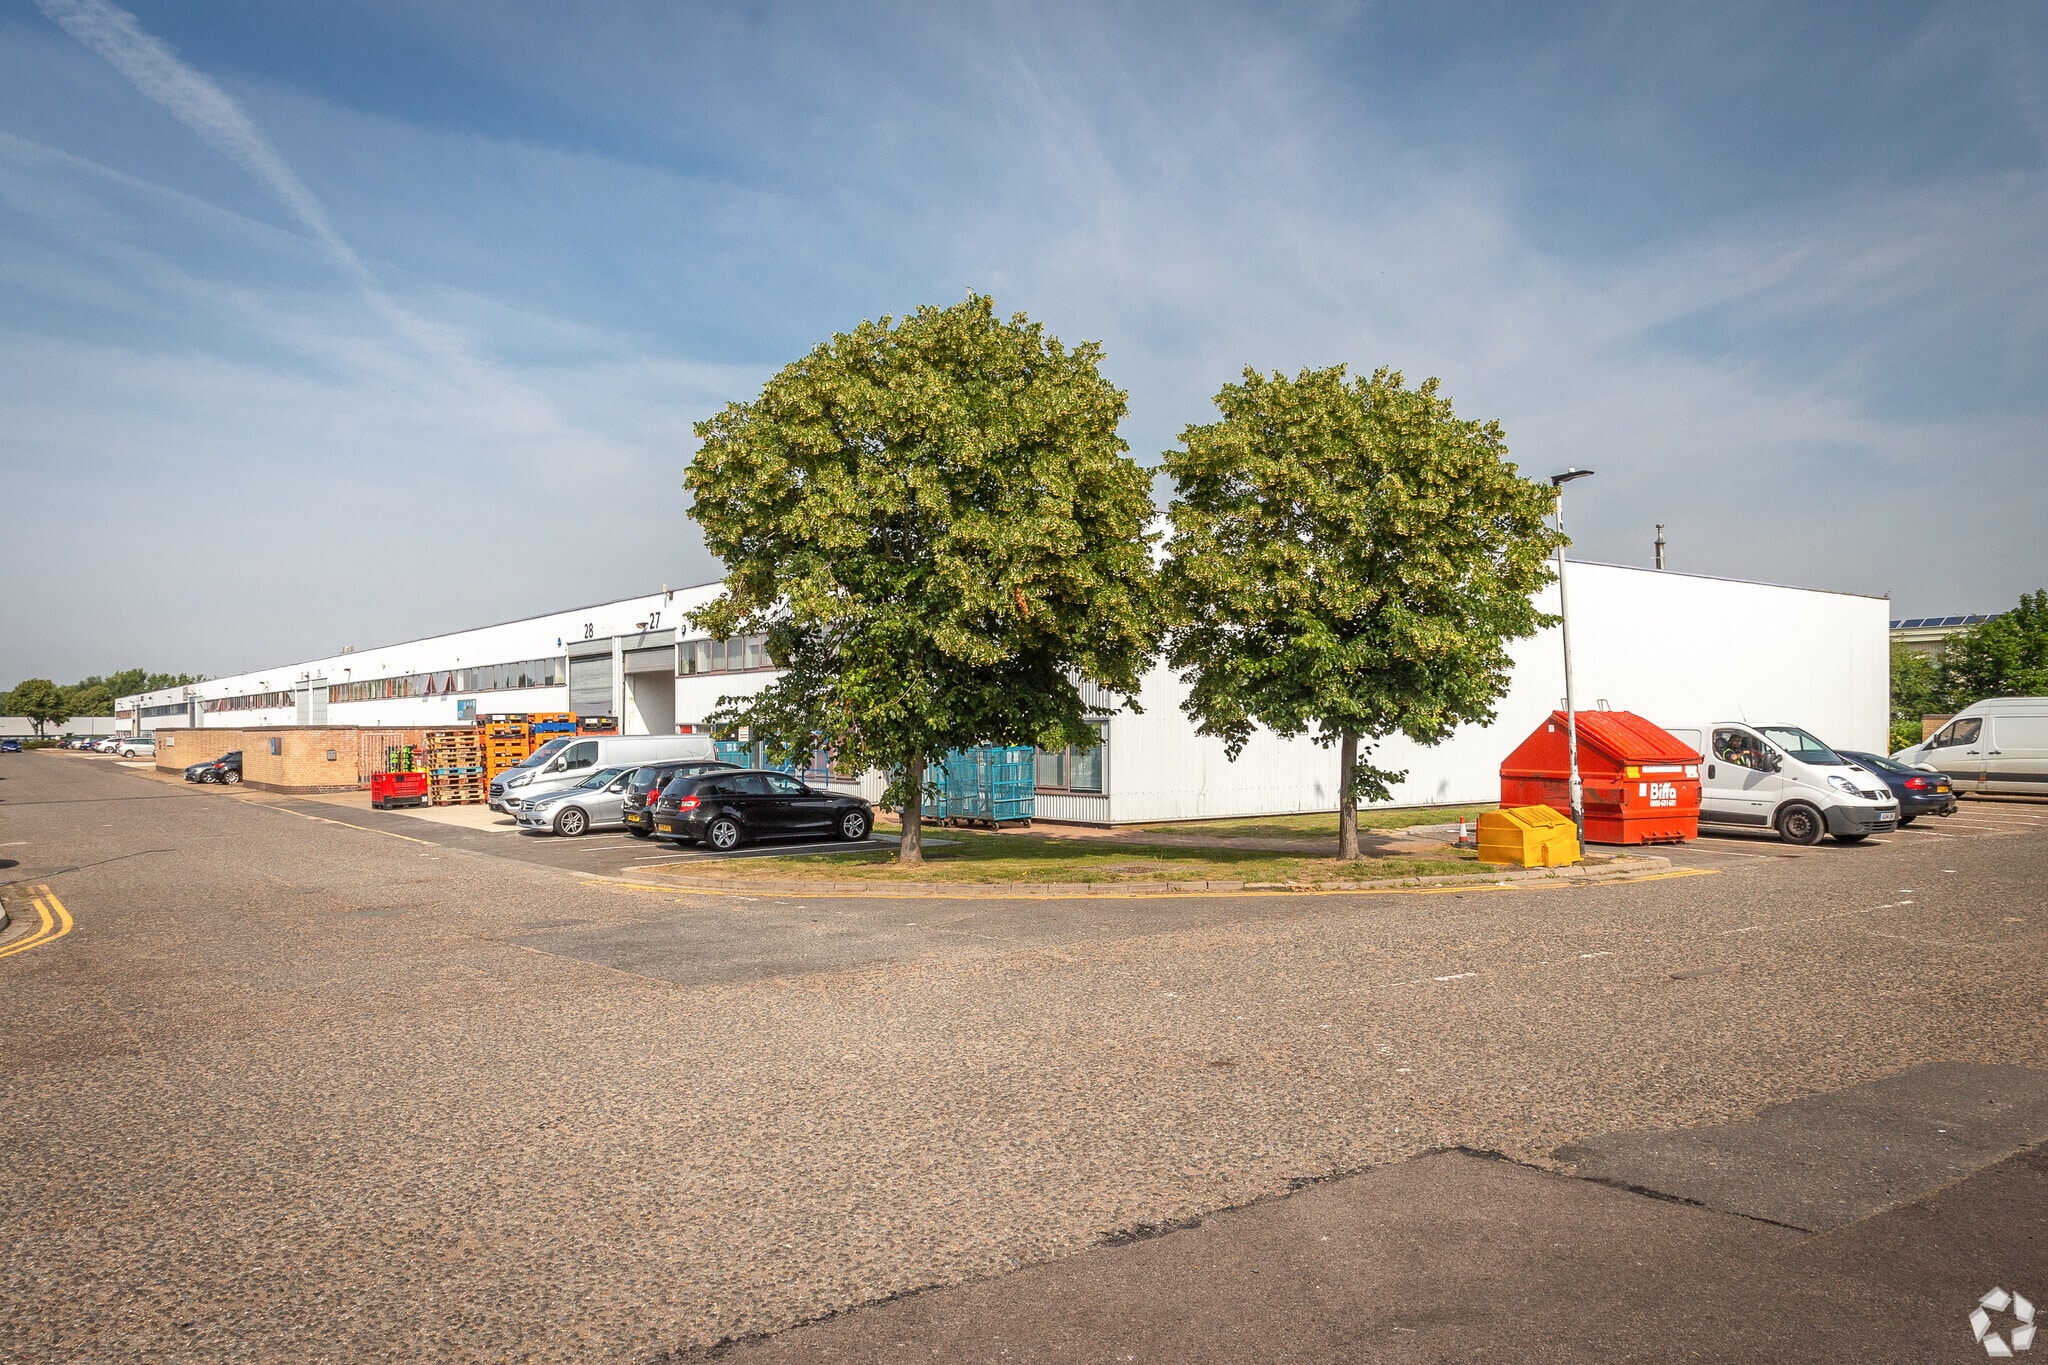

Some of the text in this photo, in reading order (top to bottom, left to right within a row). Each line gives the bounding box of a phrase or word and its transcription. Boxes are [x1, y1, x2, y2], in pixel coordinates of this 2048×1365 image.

[650, 611, 661, 630] 27
[584, 623, 594, 639] 28
[1650, 782, 1677, 800] Biffa
